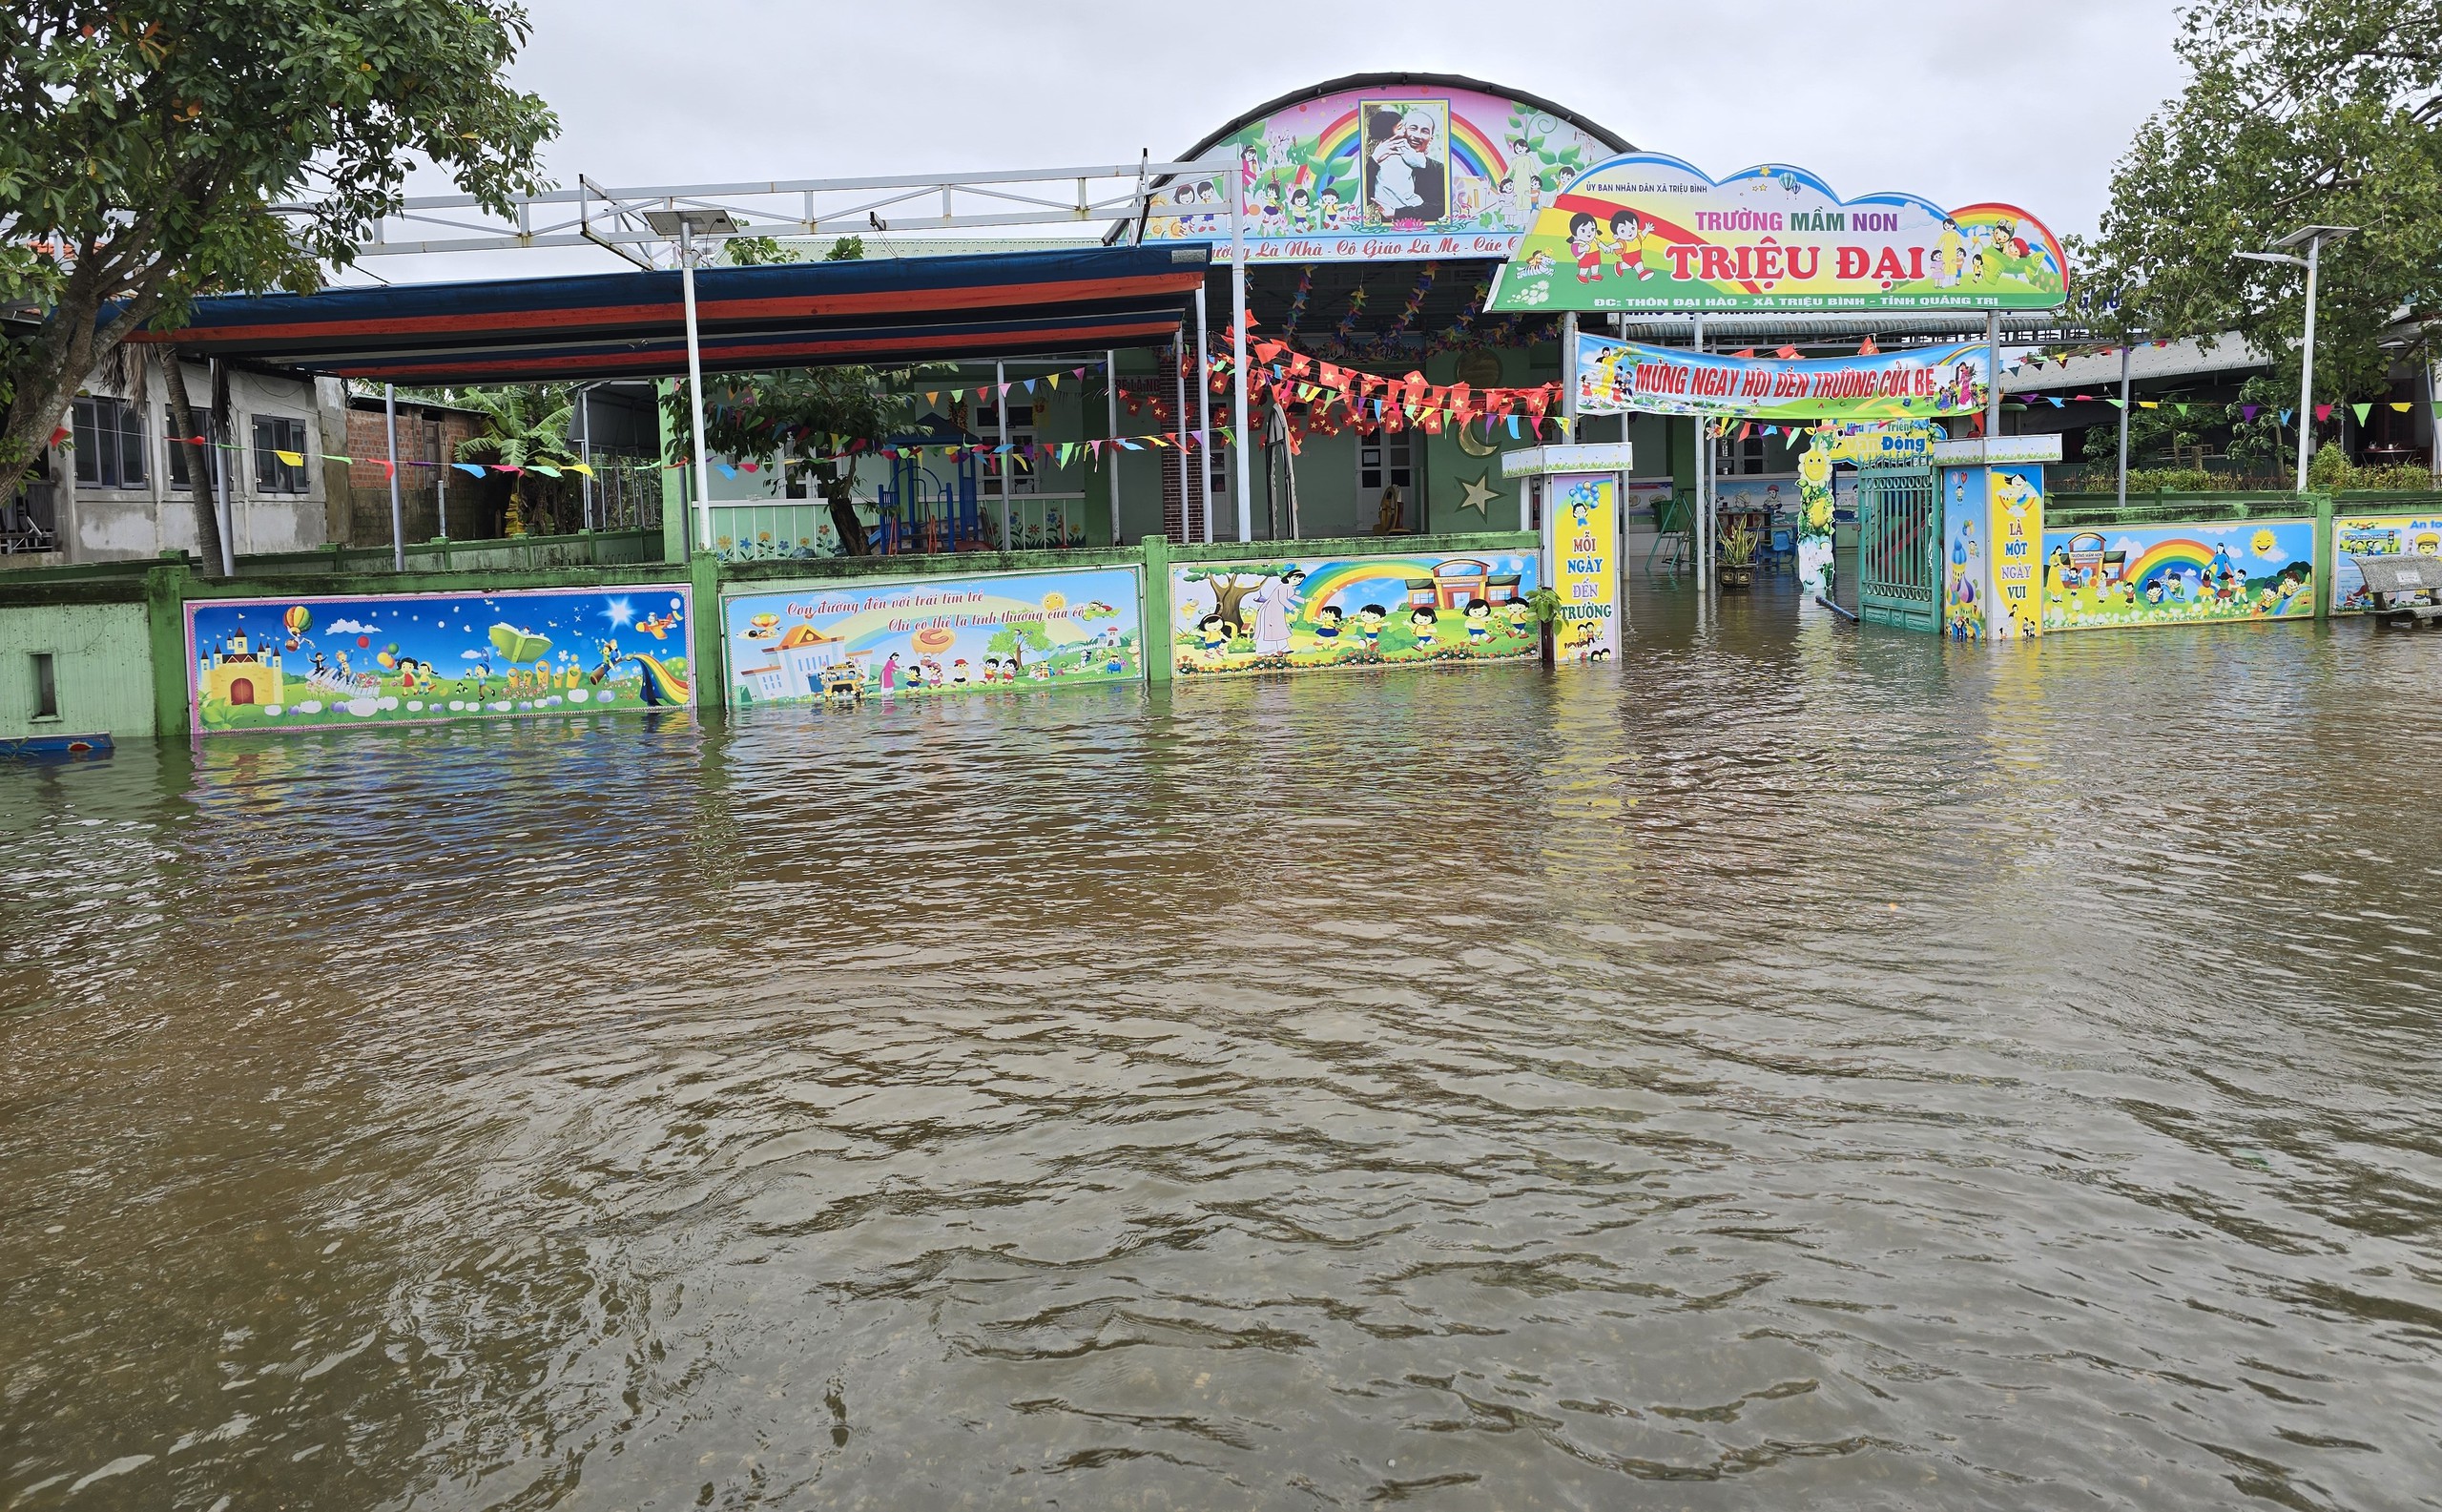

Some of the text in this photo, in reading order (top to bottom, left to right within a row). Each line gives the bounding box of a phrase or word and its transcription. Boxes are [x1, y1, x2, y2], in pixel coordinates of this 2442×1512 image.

[1586, 181, 1596, 191] ỦY
[1615, 182, 1636, 192] NHÂN
[1639, 182, 1654, 192] DÂN
[1657, 182, 1667, 193] XÃ
[1669, 182, 1687, 195] TRIỆU
[1690, 183, 1707, 193] BÌNH
[1695, 206, 1898, 232] TRƯỜNG MẦM NON
[1255, 241, 1279, 258] Là
[1285, 239, 1323, 257] Nhà
[1336, 238, 1357, 256] Cô
[1362, 238, 1402, 259] Giáo
[1407, 238, 1431, 254] Là
[1435, 237, 1460, 256] Mẹ
[1474, 236, 1501, 252] Các
[1666, 236, 1926, 290] TRIỆU ĐẠI
[1594, 298, 1622, 307] ĐC:
[1626, 296, 1669, 306] THÔN
[1672, 298, 1701, 308] ĐẠI
[1706, 296, 1737, 306] HÀO
[1752, 295, 1774, 306] XÃ
[1779, 295, 1823, 308] TRIỆU
[1828, 295, 1865, 306] BÌNH
[1879, 294, 1915, 305] TỈNH
[1919, 294, 1971, 305] QUẢNG
[1976, 297, 1998, 306] TRỊ
[1634, 359, 1688, 395] MỪNG
[1690, 364, 1740, 397] NGÀY
[1812, 365, 1877, 399] TRƯỜNG
[1878, 361, 1910, 398] CỦA
[1880, 435, 1926, 453] Động
[2009, 519, 2023, 535] LÀ
[2410, 520, 2427, 529] An
[1573, 531, 1596, 552] MỖI
[2005, 539, 2028, 559] MỘT
[1567, 555, 1603, 573] NGÀY
[2001, 562, 2031, 579] NGÀY
[1573, 578, 1598, 598] ĐẾN
[2007, 586, 2026, 599] VUI
[817, 600, 859, 615] đường
[863, 597, 886, 611] đến
[891, 595, 910, 609] với
[915, 594, 938, 607] trái
[942, 592, 962, 605] tim
[967, 590, 983, 603] trẻ
[1560, 601, 1612, 619] TRƯỜNG
[888, 617, 911, 632] Chỉ
[914, 616, 927, 630] có
[931, 613, 952, 629] thể
[955, 613, 968, 627] là
[971, 611, 997, 626] tình
[1001, 611, 1043, 624] thương
[1047, 609, 1067, 620] của
